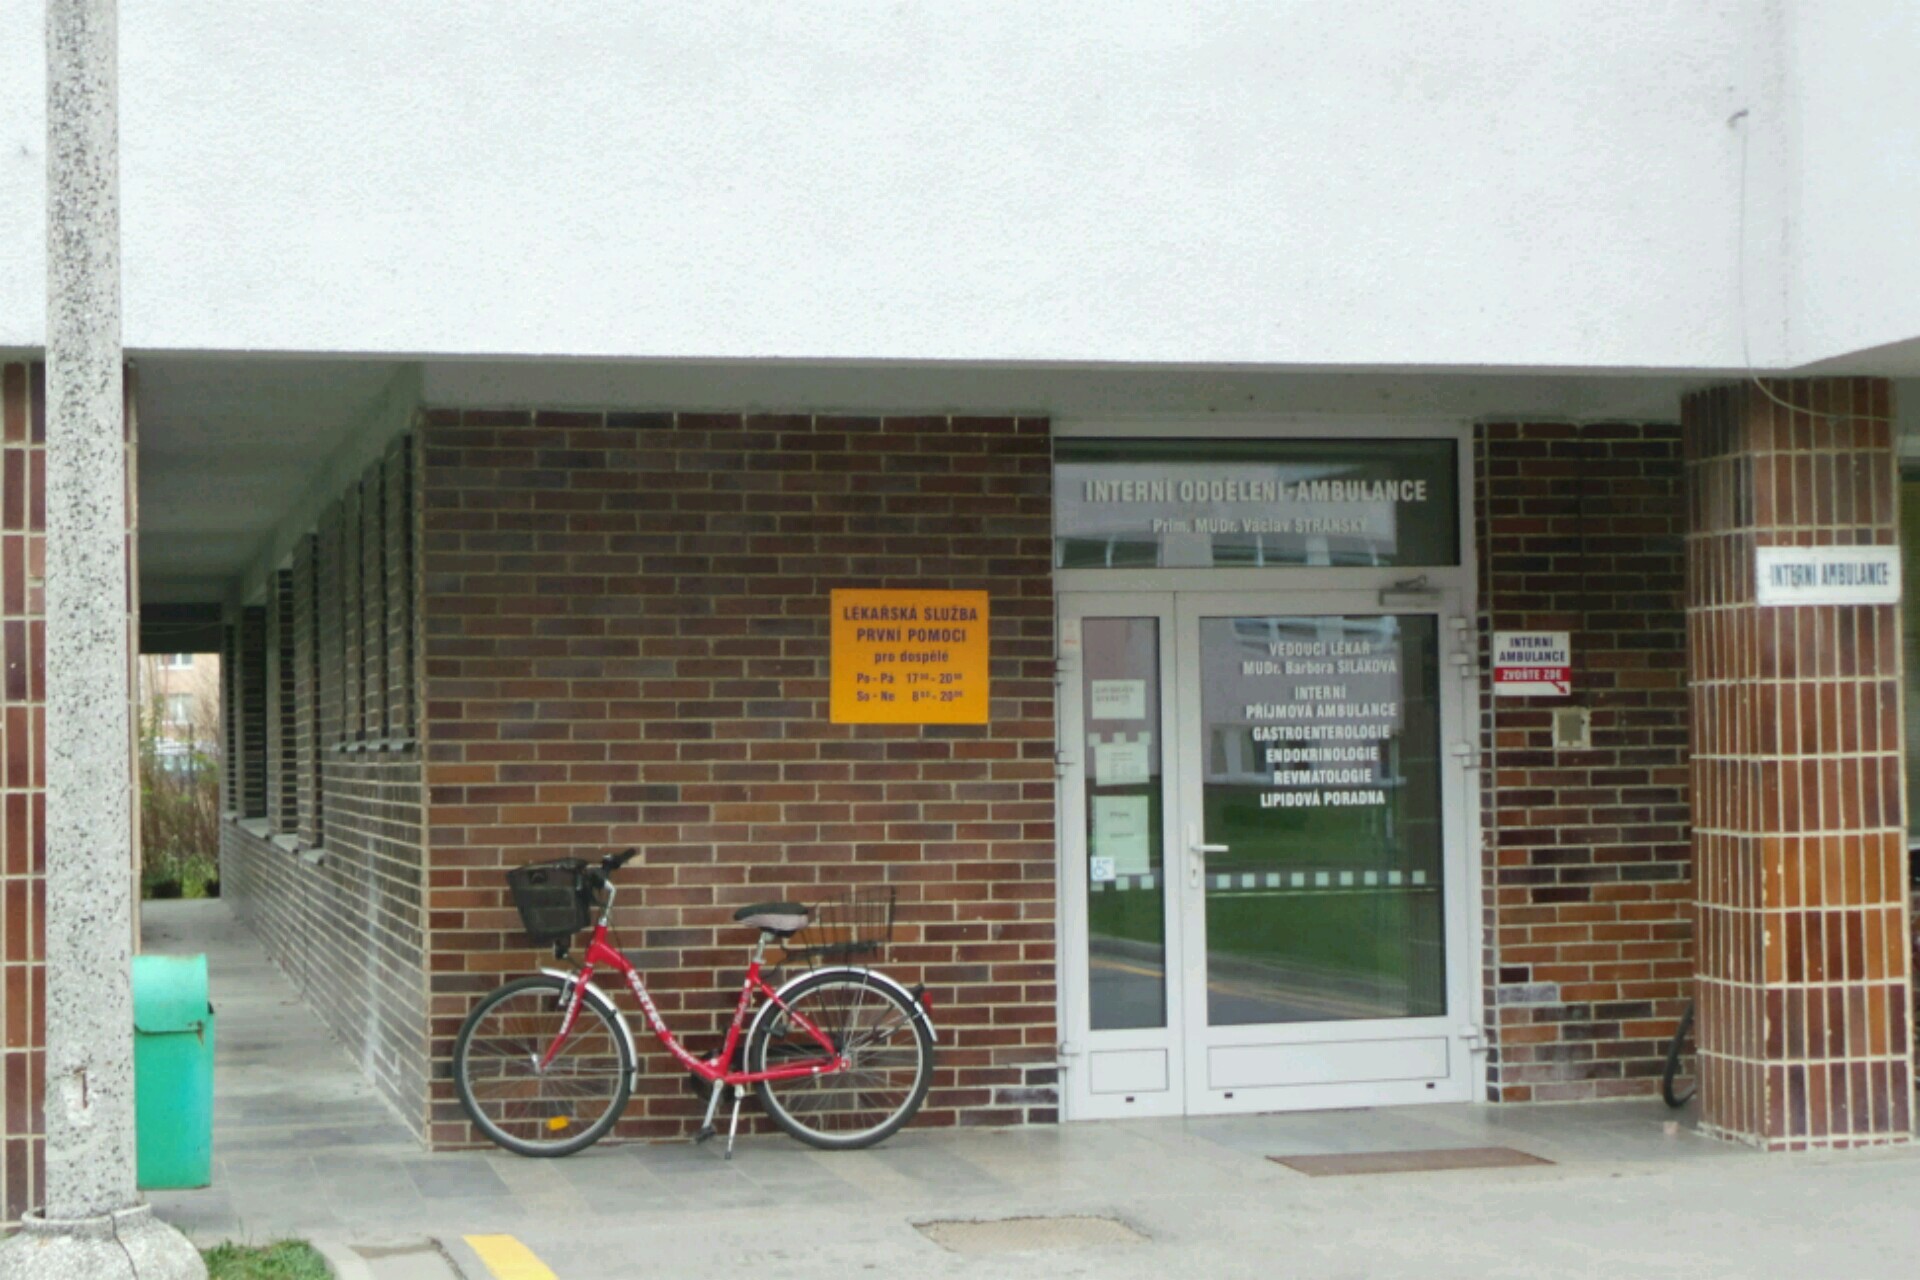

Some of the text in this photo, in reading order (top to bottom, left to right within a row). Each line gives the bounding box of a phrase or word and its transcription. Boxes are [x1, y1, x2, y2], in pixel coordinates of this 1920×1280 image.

[1085, 477, 1172, 502] INTERNÍ
[1195, 517, 1238, 534] MUDr.
[1821, 562, 1889, 586] AMBULANCE
[843, 604, 978, 621] LÉKAŘSKÁ SLUŽBA
[857, 626, 966, 642] PRVNÍ POMOCI
[874, 649, 949, 665] pro dospělé
[1499, 651, 1566, 662] AMBULANCE
[1242, 660, 1282, 675] MUDr.
[1285, 659, 1334, 675] Barbora
[1543, 668, 1563, 681] ZDE
[880, 690, 895, 702] Ne
[1294, 683, 1347, 701] INTERNÍ
[1246, 701, 1397, 719] PŘÍJMOVÁ AMBULANCE
[1252, 725, 1390, 742] GASTROENTEROLOGIE
[1266, 746, 1378, 763] ENDOKRINOLOGIE
[1273, 768, 1372, 785] REVMATOLOGIE
[1260, 788, 1385, 807] LIPIDOVÁ PORADNA
